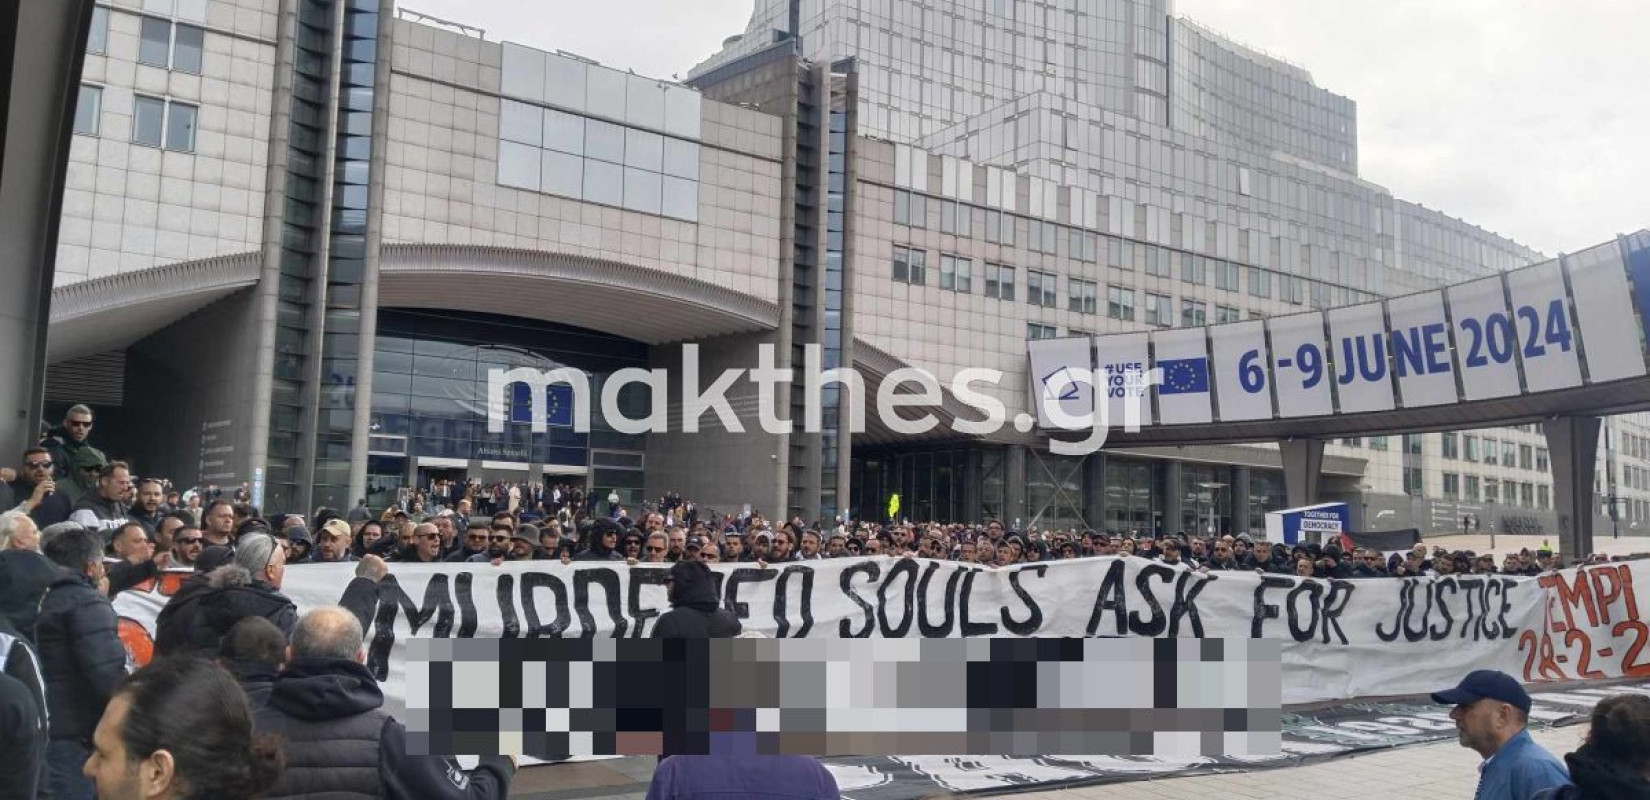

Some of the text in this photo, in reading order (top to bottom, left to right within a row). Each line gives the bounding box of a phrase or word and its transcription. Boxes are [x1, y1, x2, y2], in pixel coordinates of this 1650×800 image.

[1338, 323, 1450, 385] JUNE
[1460, 299, 1571, 368] 2024
[1303, 520, 1339, 529] DEMOCRACY
[367, 558, 1519, 682] MURDEED SOULS ASK FOR JUSTICE
[1537, 564, 1640, 634] TEMPI
